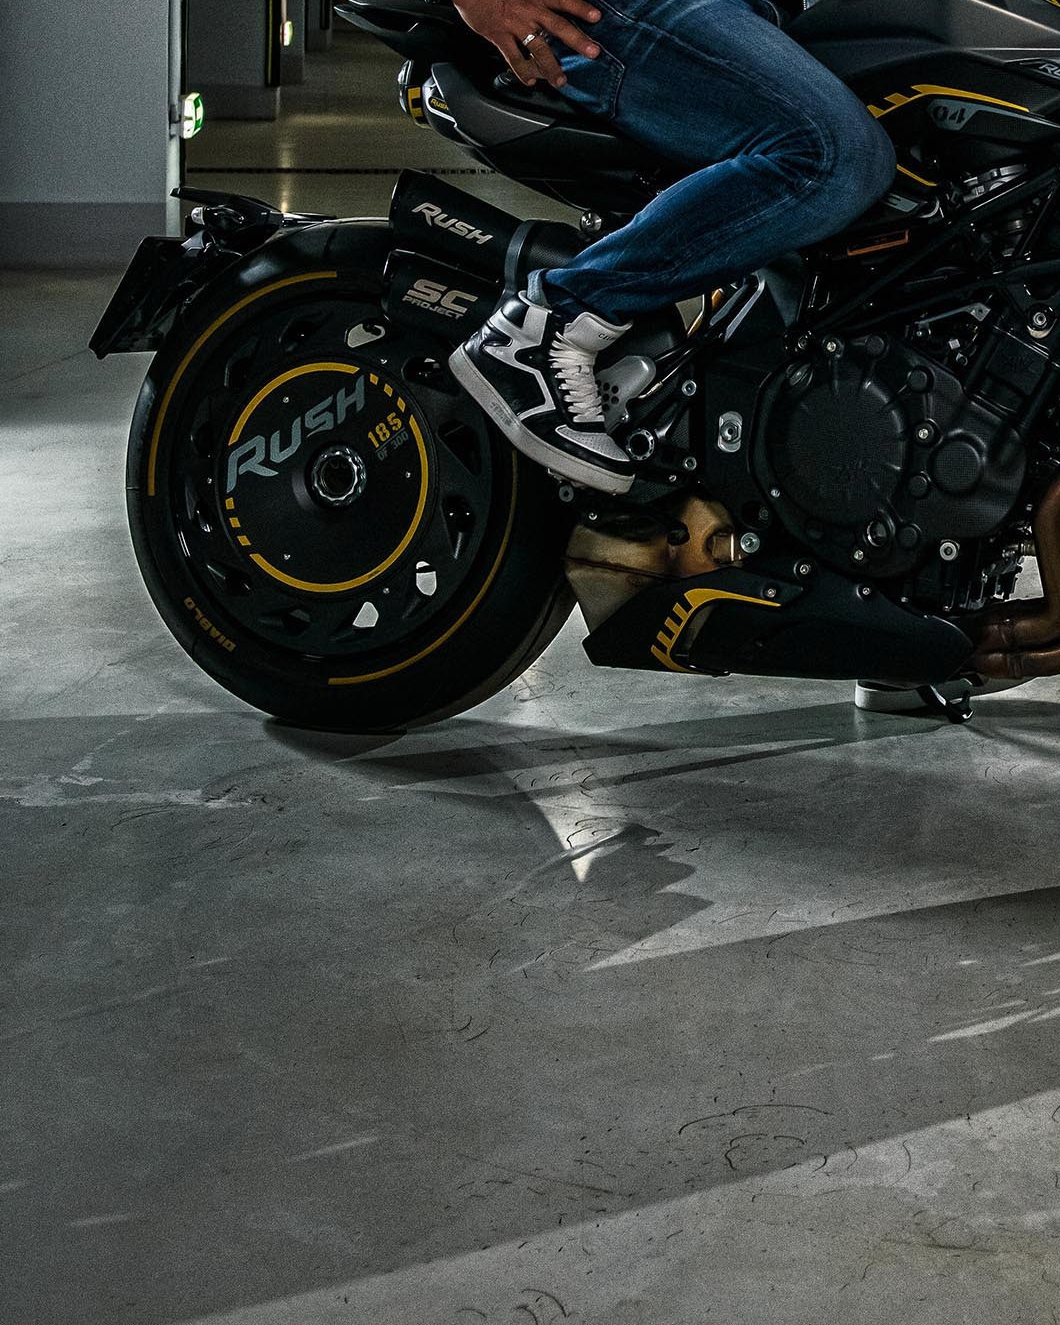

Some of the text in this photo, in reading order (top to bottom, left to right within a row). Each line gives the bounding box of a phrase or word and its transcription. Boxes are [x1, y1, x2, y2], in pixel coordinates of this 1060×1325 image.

[411, 202, 494, 245] RUSH
[402, 295, 464, 320] PROJECT
[406, 278, 479, 314] SC
[227, 375, 365, 493] RUSH
[367, 412, 402, 448] 185
[376, 432, 409, 461] OF 300
[184, 597, 236, 651] DIABLO
